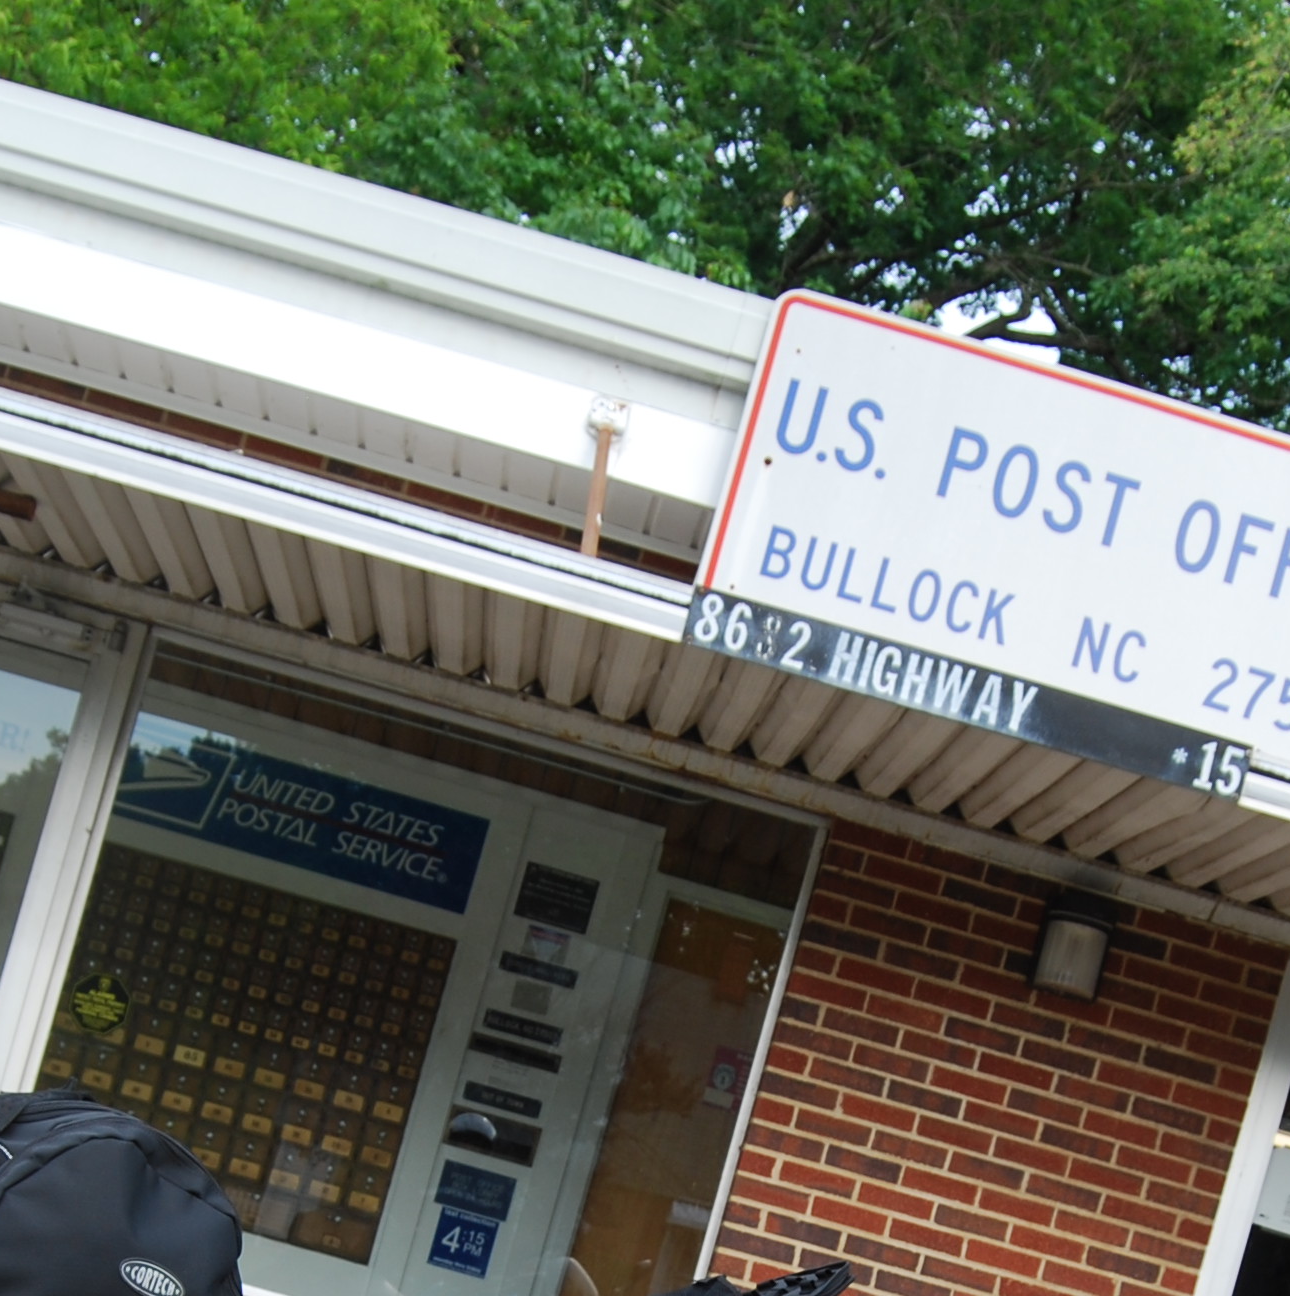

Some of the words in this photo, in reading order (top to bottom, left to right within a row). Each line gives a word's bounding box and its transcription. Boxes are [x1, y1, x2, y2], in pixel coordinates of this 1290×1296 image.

[775, 378, 887, 481] U.S.
[936, 425, 1142, 547] POST
[760, 525, 1017, 646] BULLOCK
[1070, 616, 1147, 684] NC
[828, 629, 1040, 733] HIGHWAY
[1193, 740, 1246, 797] 15
[216, 798, 317, 847] POSTAL
[232, 769, 336, 815] UNITED
[341, 801, 445, 847] STATES
[462, 1242, 483, 1257] PM
